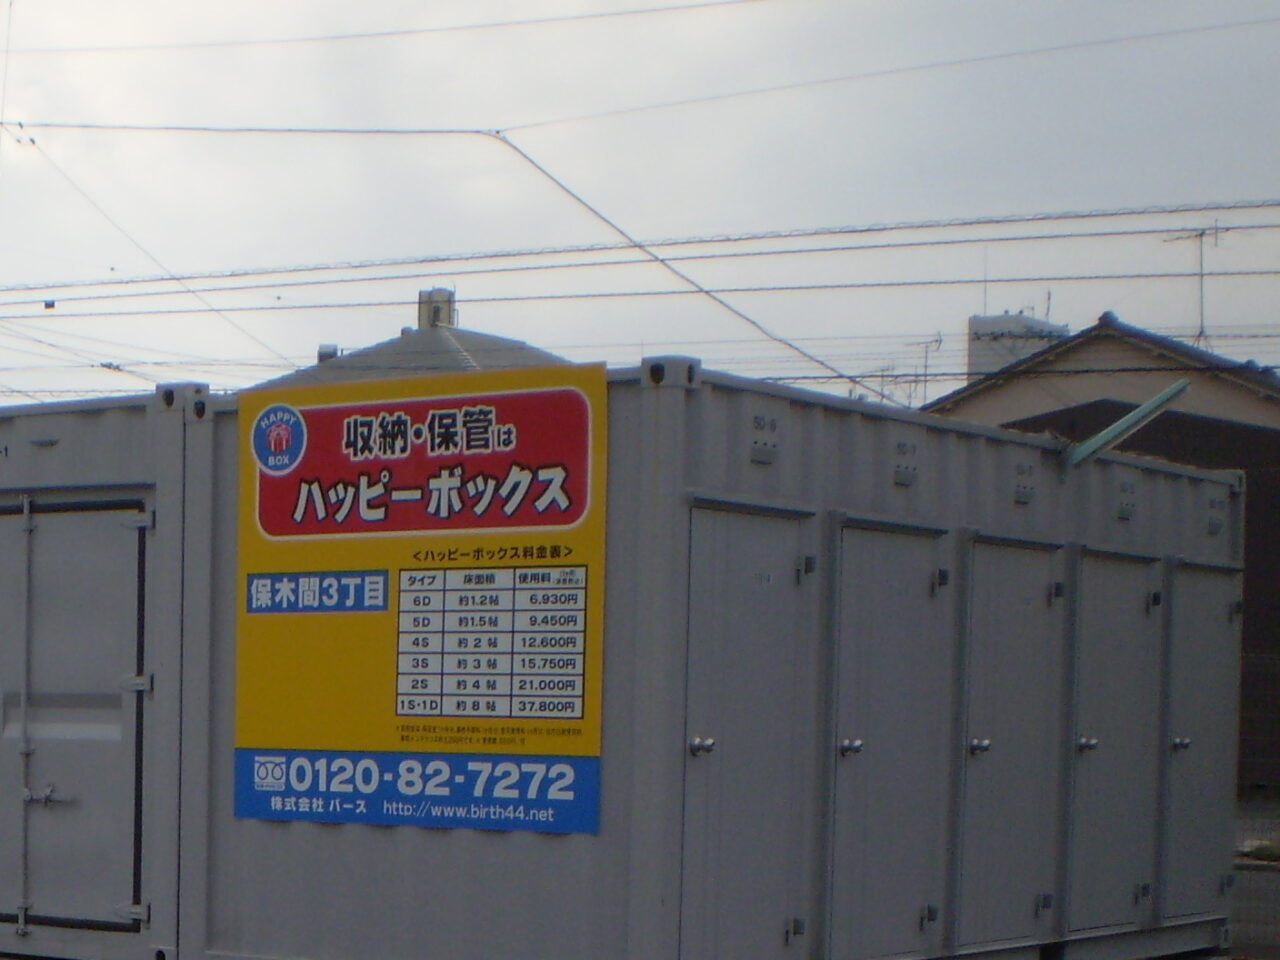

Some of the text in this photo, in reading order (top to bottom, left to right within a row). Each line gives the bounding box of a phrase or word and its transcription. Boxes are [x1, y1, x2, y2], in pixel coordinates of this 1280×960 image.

[260, 411, 297, 430] HAPPY
[268, 455, 290, 466] BOX
[292, 464, 572, 525] ハッピーボックス
[251, 576, 385, 608] 保木間3丁目
[413, 595, 432, 606] 6D
[413, 616, 431, 628] 5D
[412, 637, 430, 648] 4S
[411, 658, 429, 669] 3S
[411, 679, 429, 690] 2S
[288, 757, 575, 801] 0120-82-7272
[270, 797, 368, 814] 株式会社 バース
[383, 800, 555, 822] http://www.birth44.net
